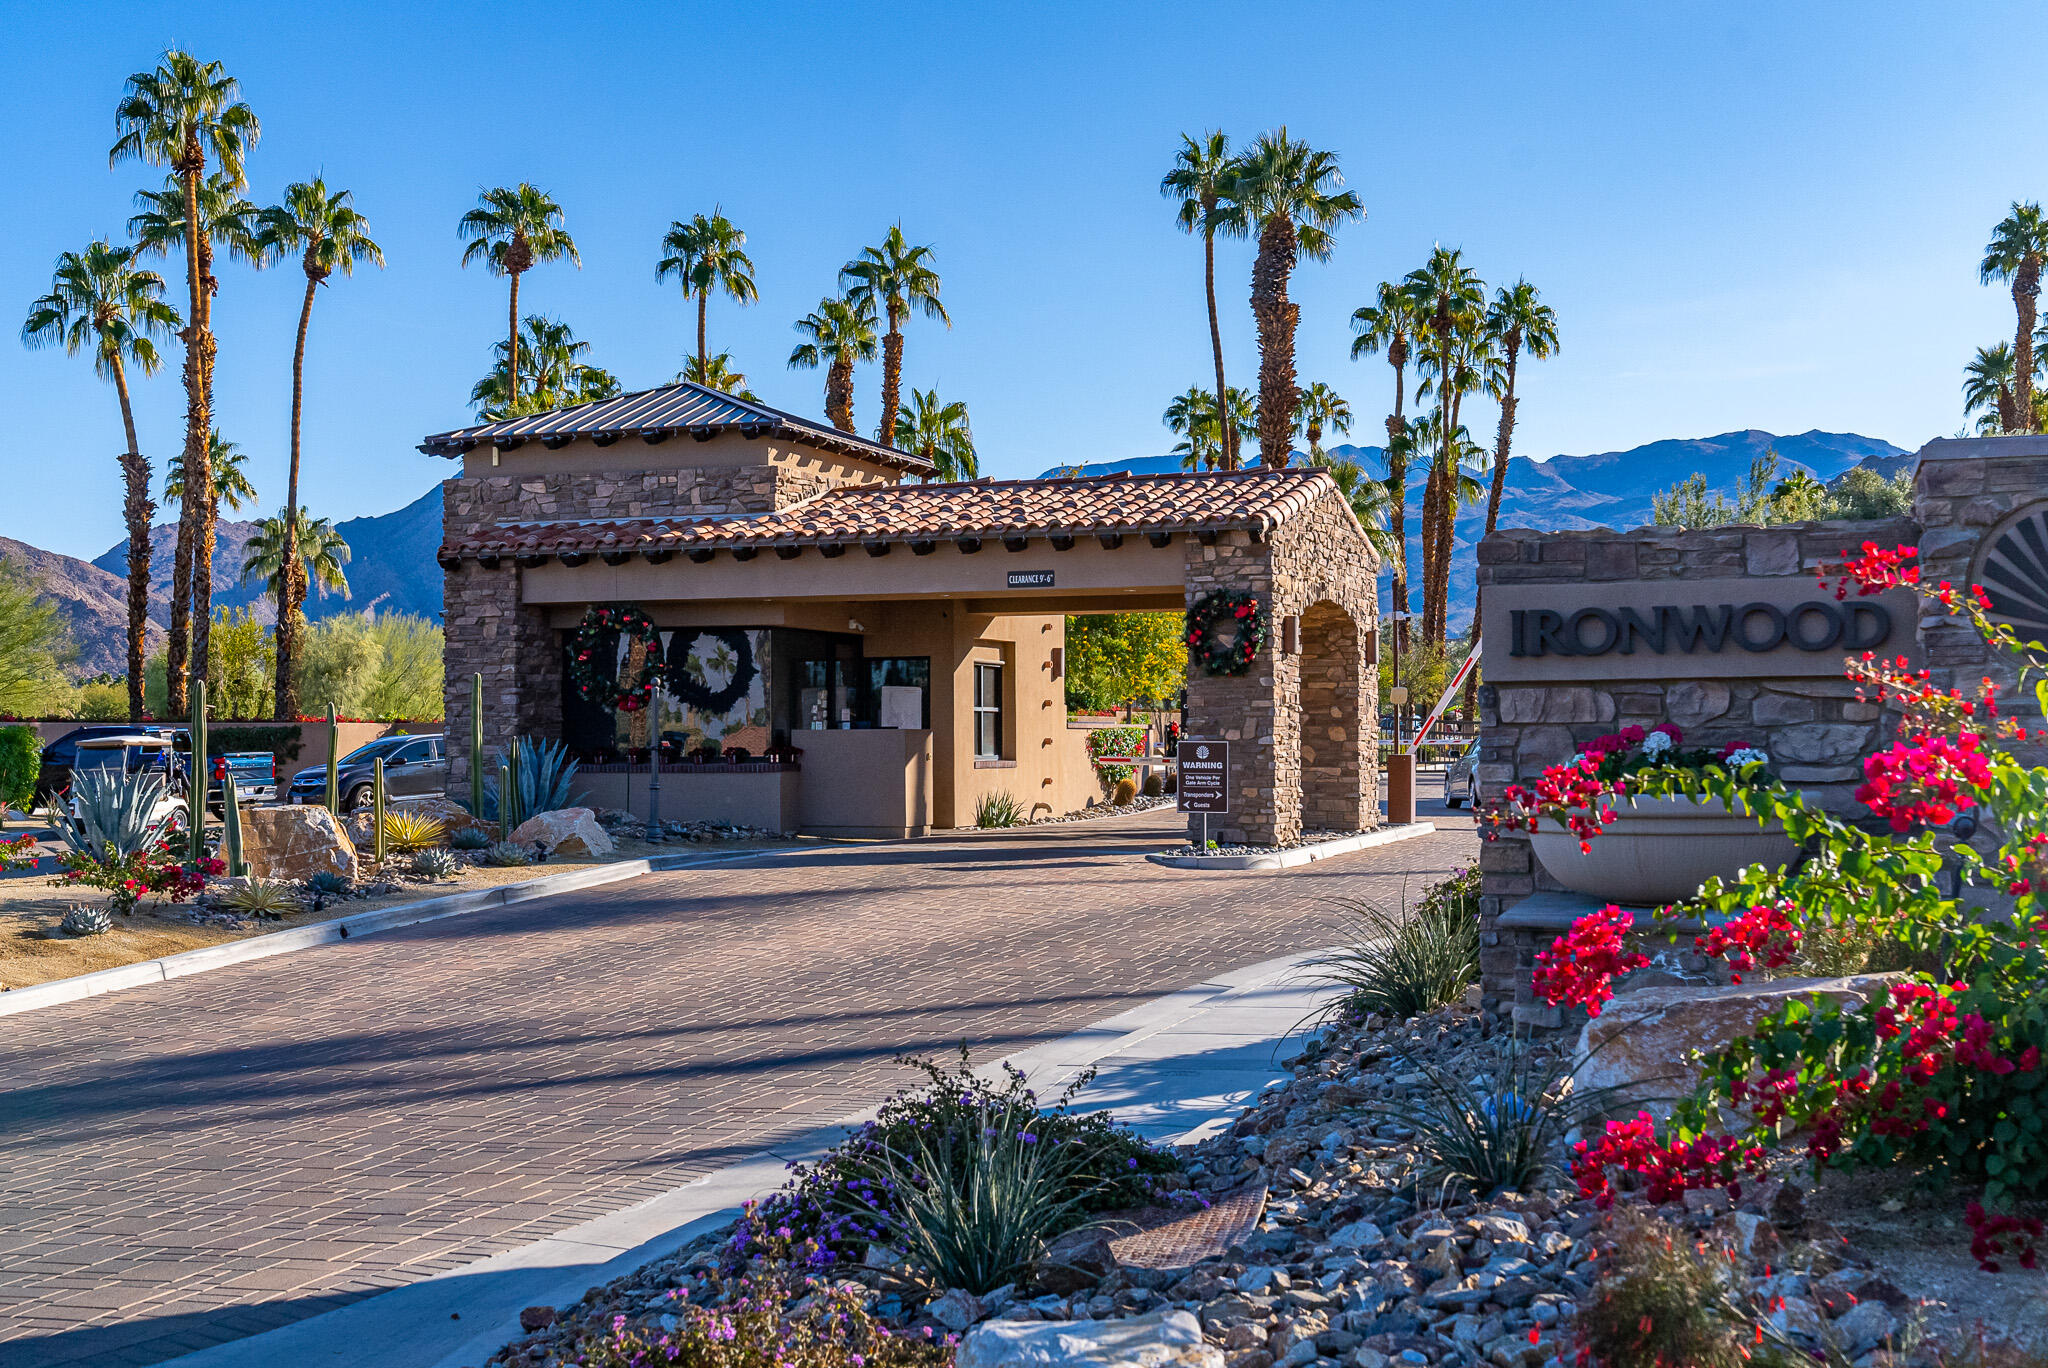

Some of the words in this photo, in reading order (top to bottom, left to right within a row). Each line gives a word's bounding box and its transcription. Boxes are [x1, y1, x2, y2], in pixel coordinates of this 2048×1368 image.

[1009, 575, 1039, 584] CLEARANCE
[1509, 601, 1891, 657] IRONWOOD
[1182, 761, 1223, 769] WARNING
